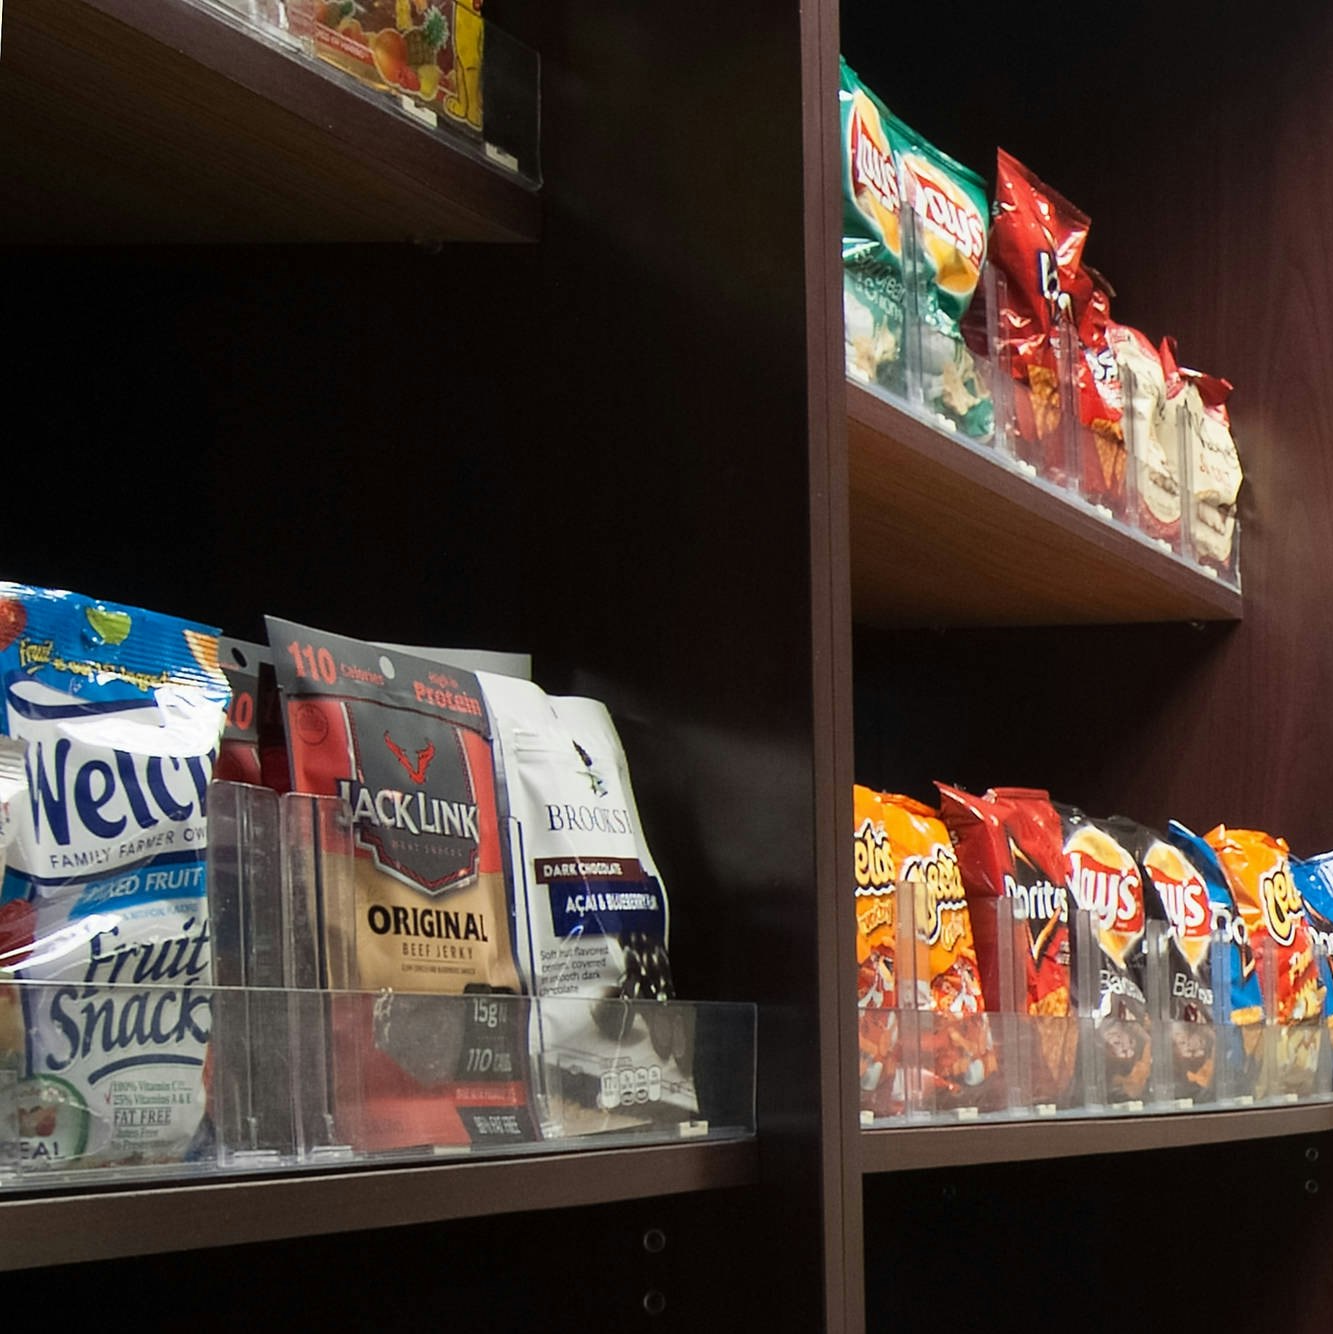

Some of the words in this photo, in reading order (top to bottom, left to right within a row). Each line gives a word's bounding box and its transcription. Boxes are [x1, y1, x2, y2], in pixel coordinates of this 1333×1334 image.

[288, 641, 338, 686] 110
[412, 680, 482, 717] Protein
[335, 779, 421, 835] JACK
[50, 846, 114, 869] FAMILY
[118, 829, 176, 858] FARMER
[145, 866, 204, 893] FRUIT
[543, 863, 578, 878] DARK
[1065, 851, 1139, 931] Lay's
[368, 904, 488, 942] ORIGINAL
[82, 916, 209, 998] Fruit
[402, 942, 431, 957] BEEF
[436, 945, 474, 960] JERKY
[466, 1048, 493, 1073] 110
[114, 1109, 136, 1125] FAT
[140, 1107, 171, 1124] FREE
